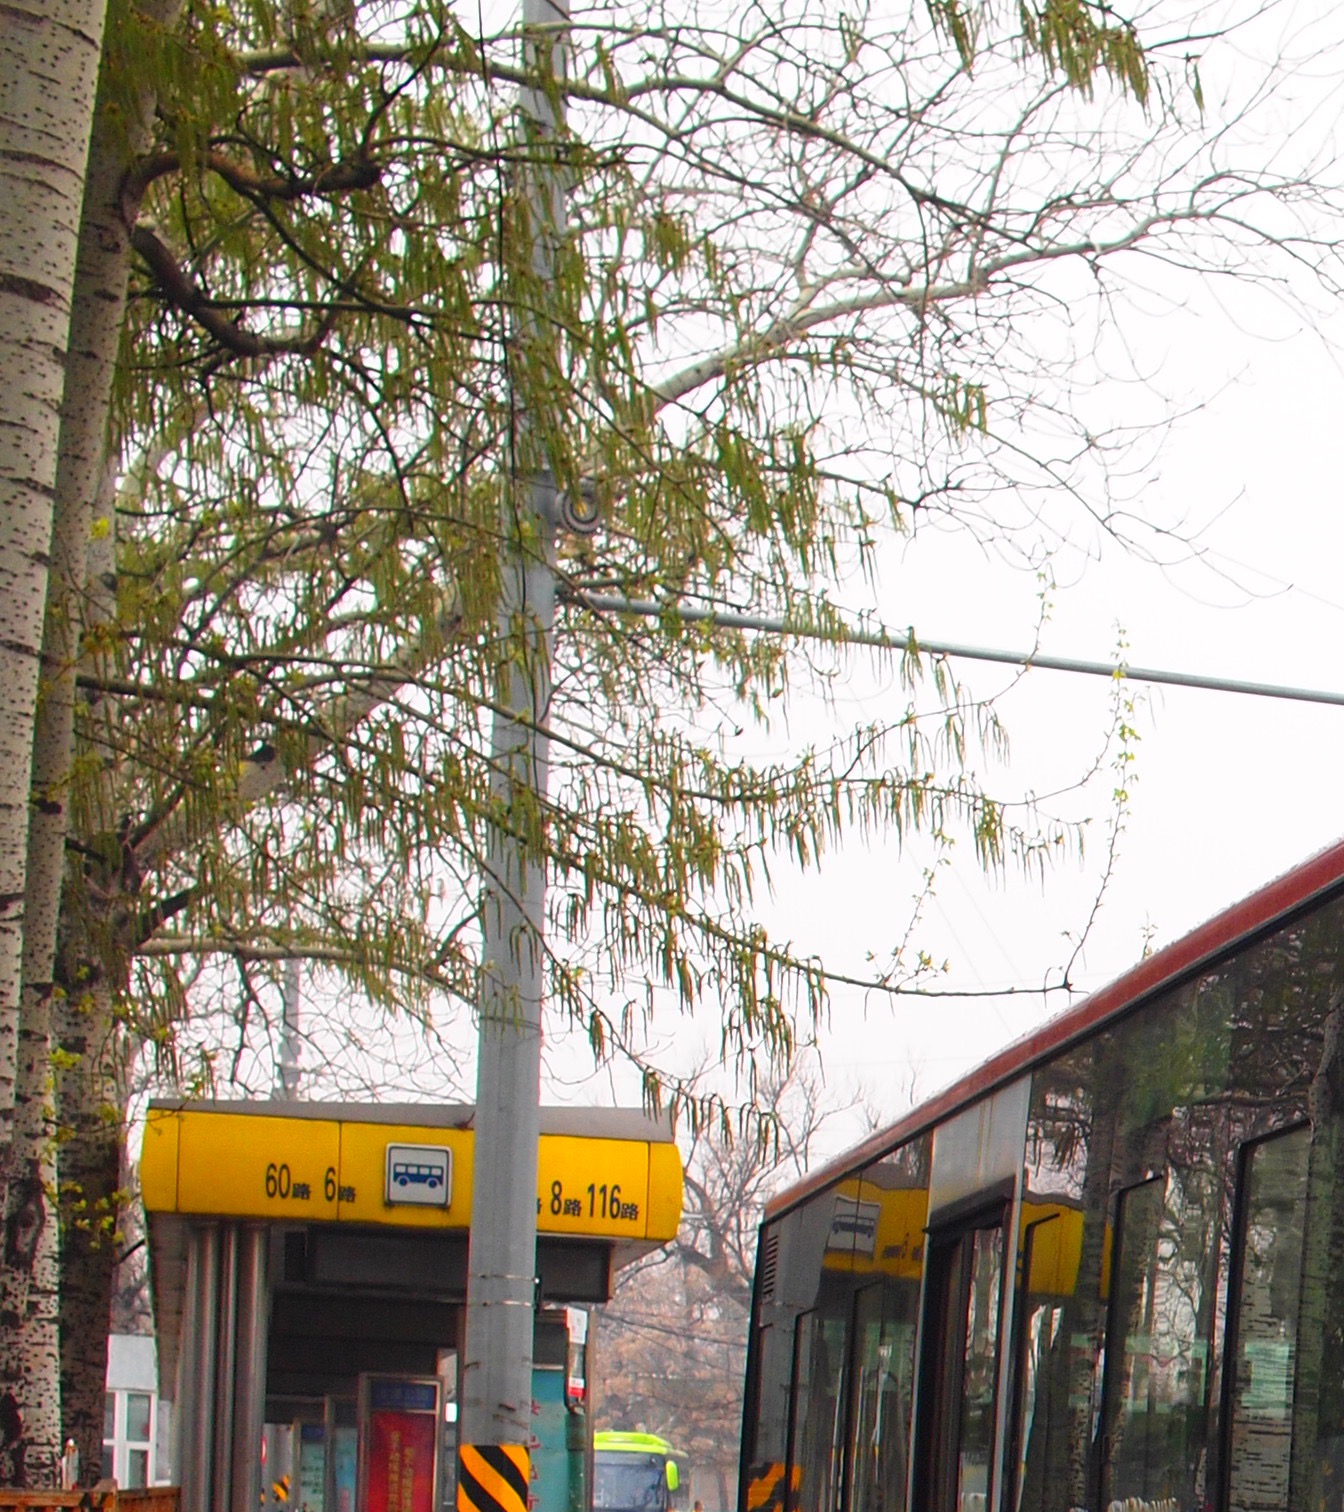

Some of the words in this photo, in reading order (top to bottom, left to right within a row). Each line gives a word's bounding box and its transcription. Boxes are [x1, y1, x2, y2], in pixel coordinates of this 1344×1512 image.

[265, 1163, 311, 1200] 60路
[324, 1166, 356, 1203] 6路
[550, 1180, 582, 1218] 8路
[587, 1183, 639, 1222] 116路
